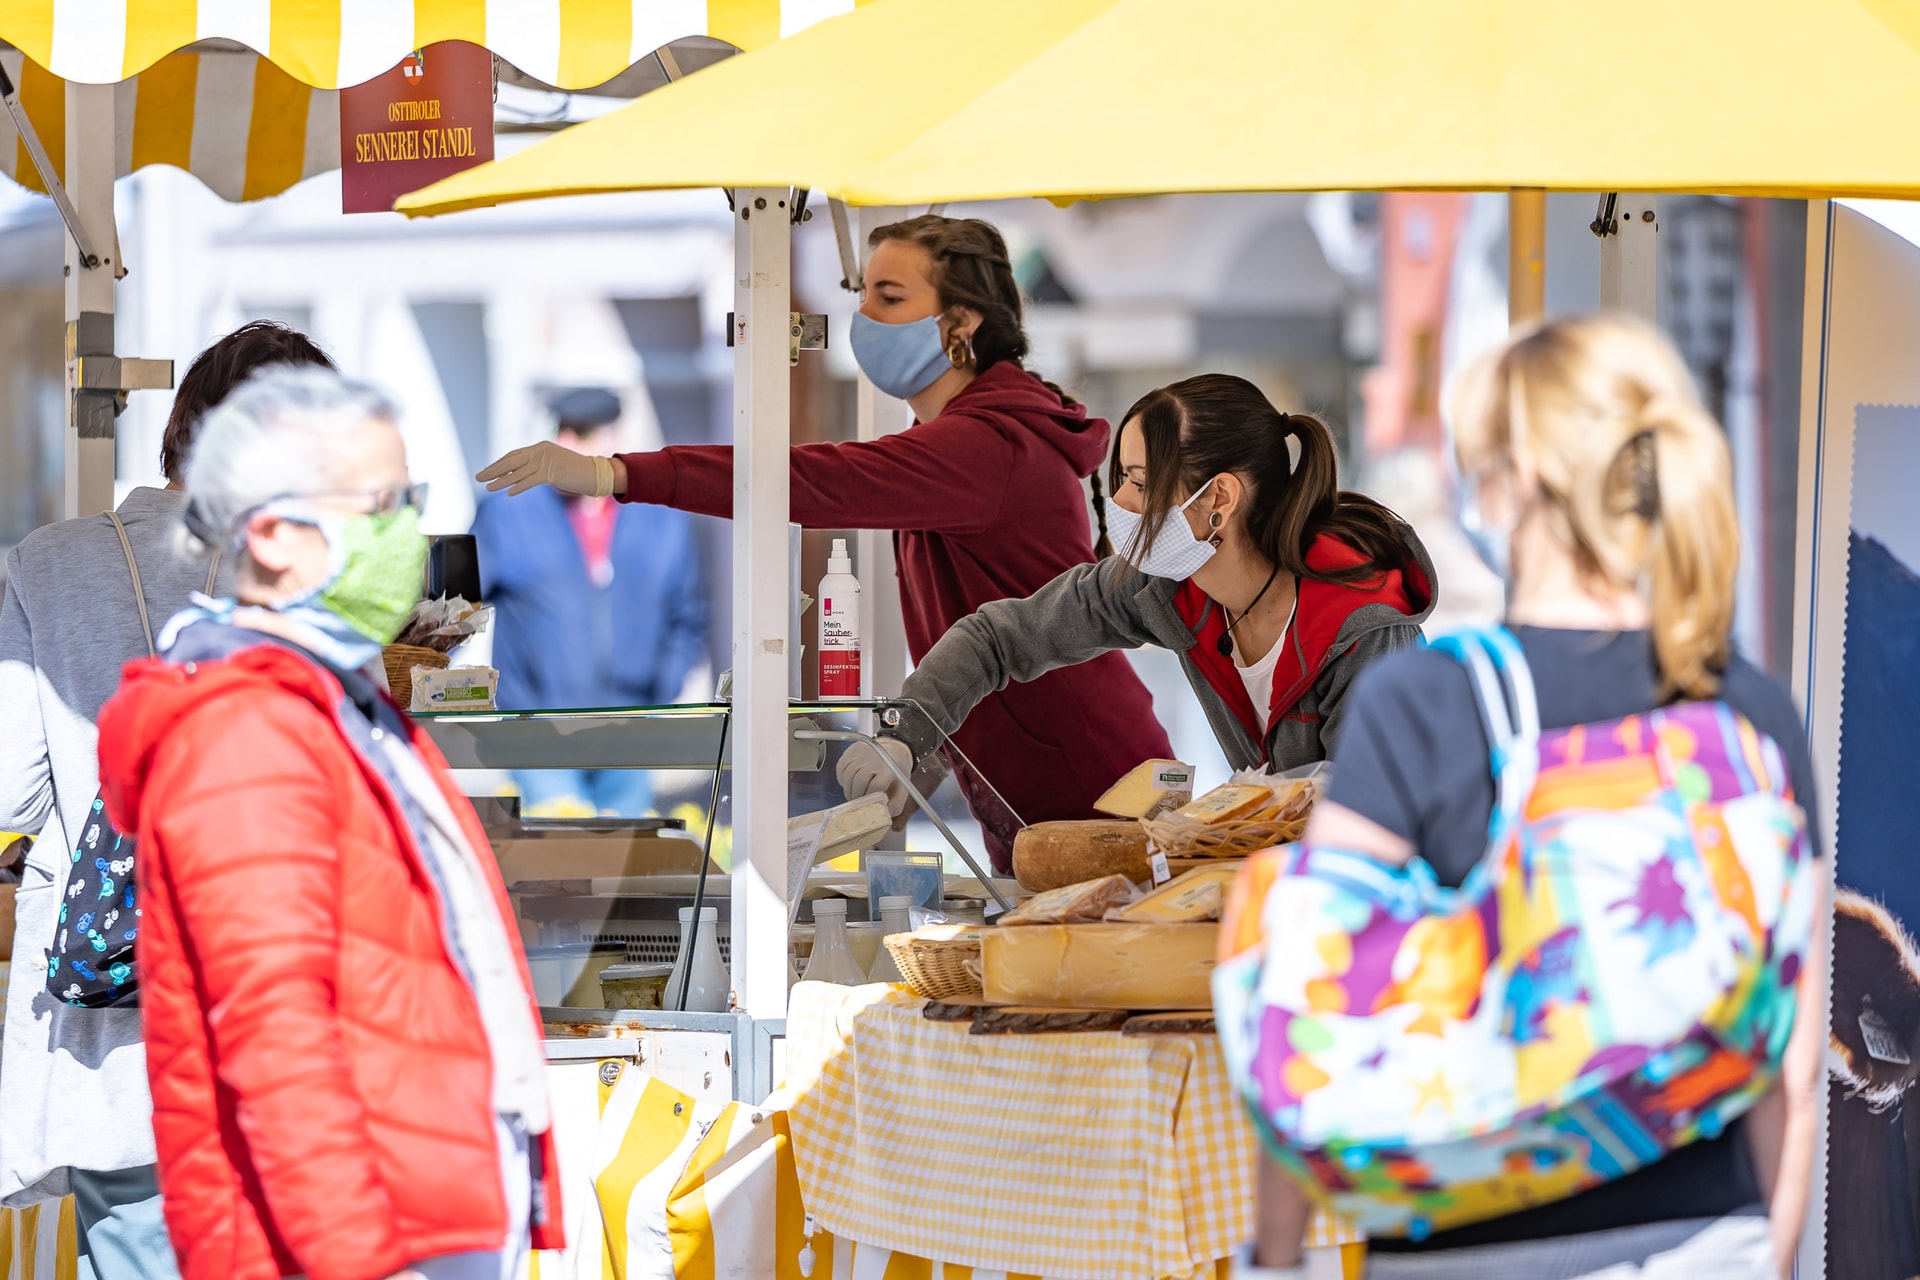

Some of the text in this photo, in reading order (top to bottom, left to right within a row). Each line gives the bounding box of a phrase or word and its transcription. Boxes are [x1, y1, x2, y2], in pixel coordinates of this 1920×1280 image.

[388, 100, 441, 122] OSTTIROLER
[355, 127, 476, 163] SENNEREI STANDL
